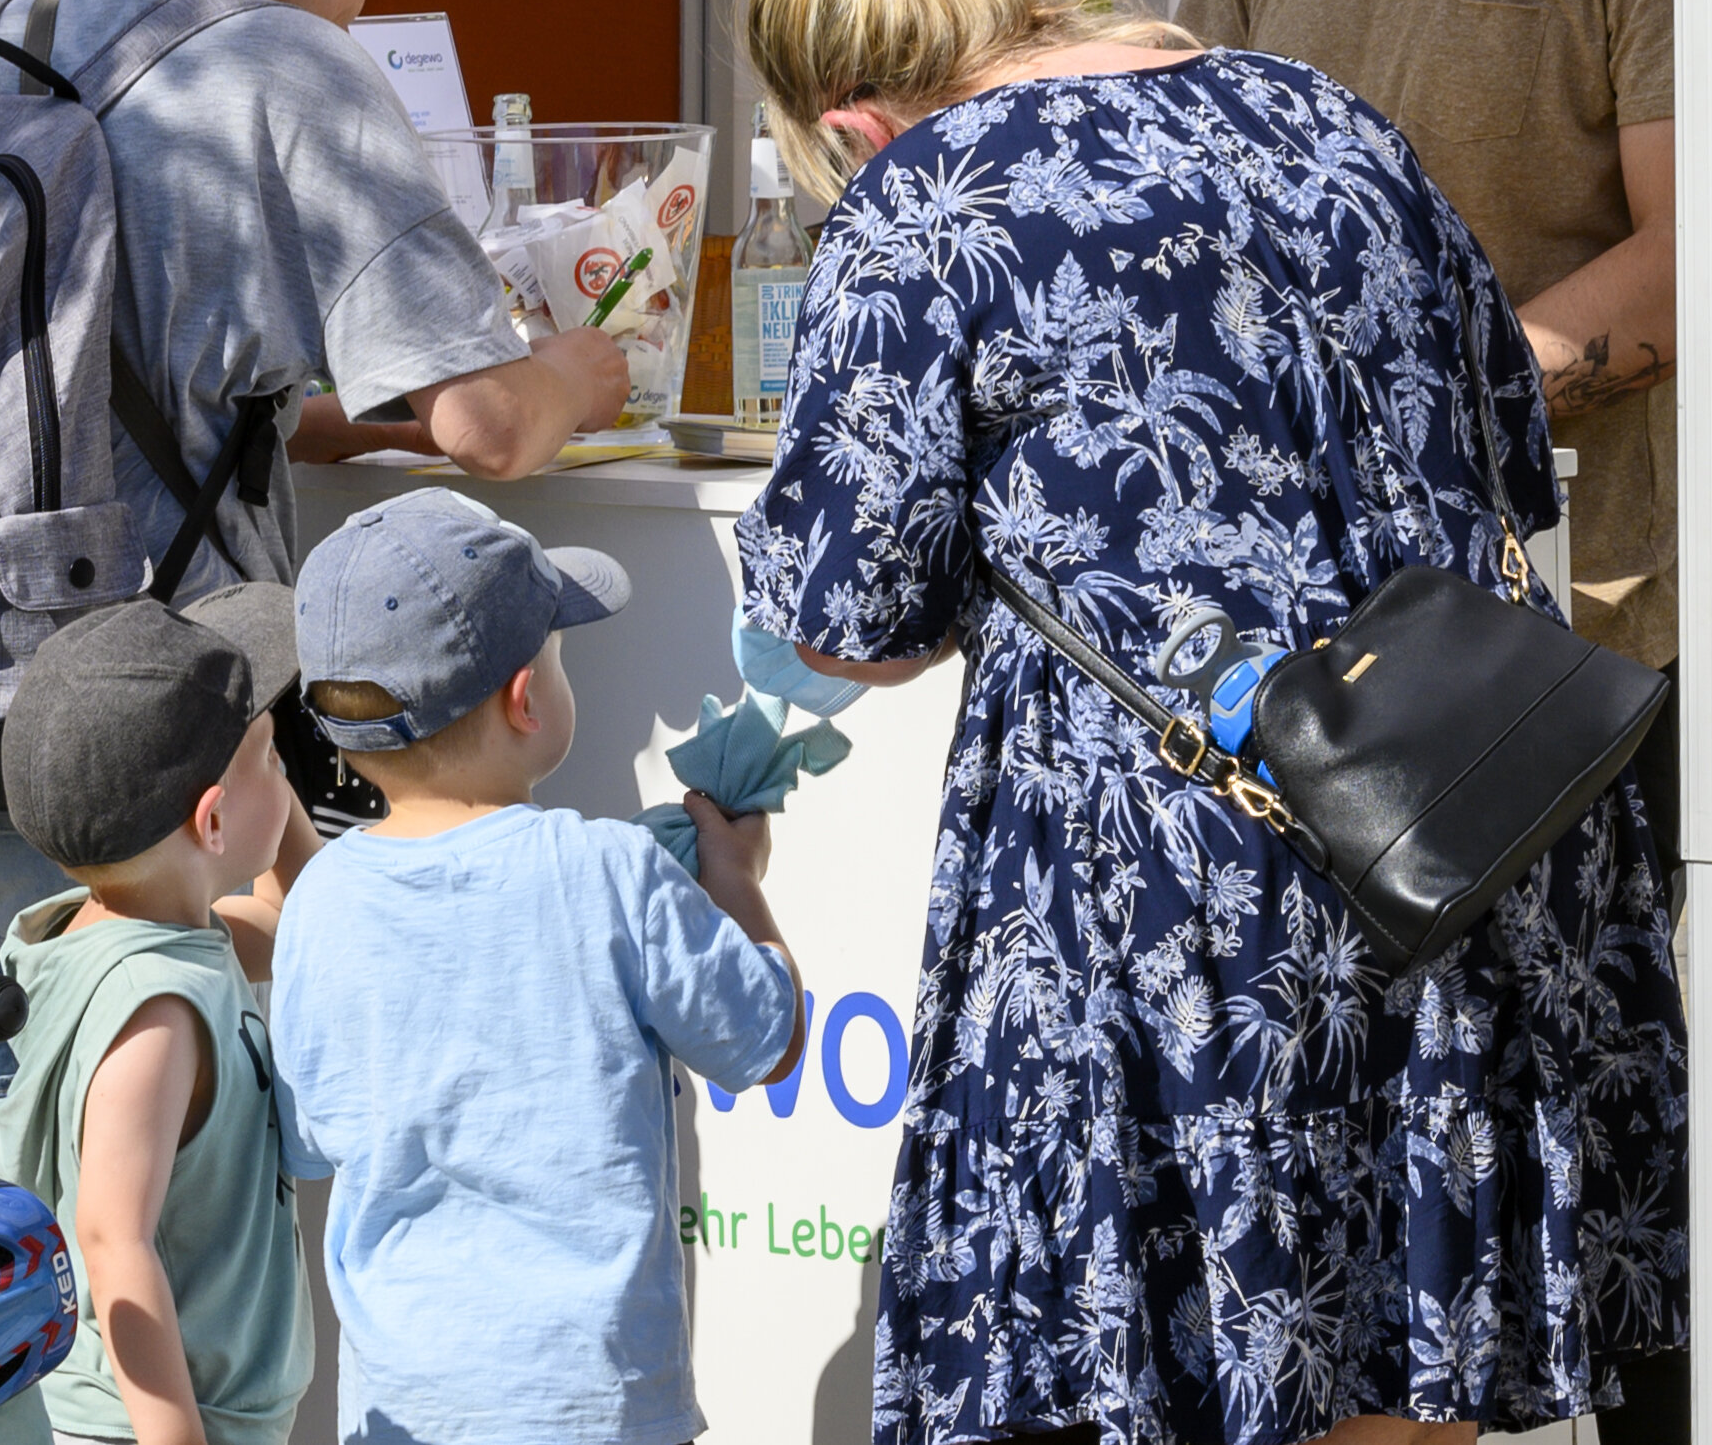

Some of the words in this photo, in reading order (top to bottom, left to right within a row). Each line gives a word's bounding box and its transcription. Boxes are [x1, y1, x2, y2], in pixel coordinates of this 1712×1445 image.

[405, 51, 444, 68] degewo
[776, 284, 804, 300] TRIN
[769, 300, 801, 321] KLI
[680, 1191, 748, 1250] ehr
[768, 1202, 884, 1265] Lebe
[52, 1250, 77, 1315] KED
